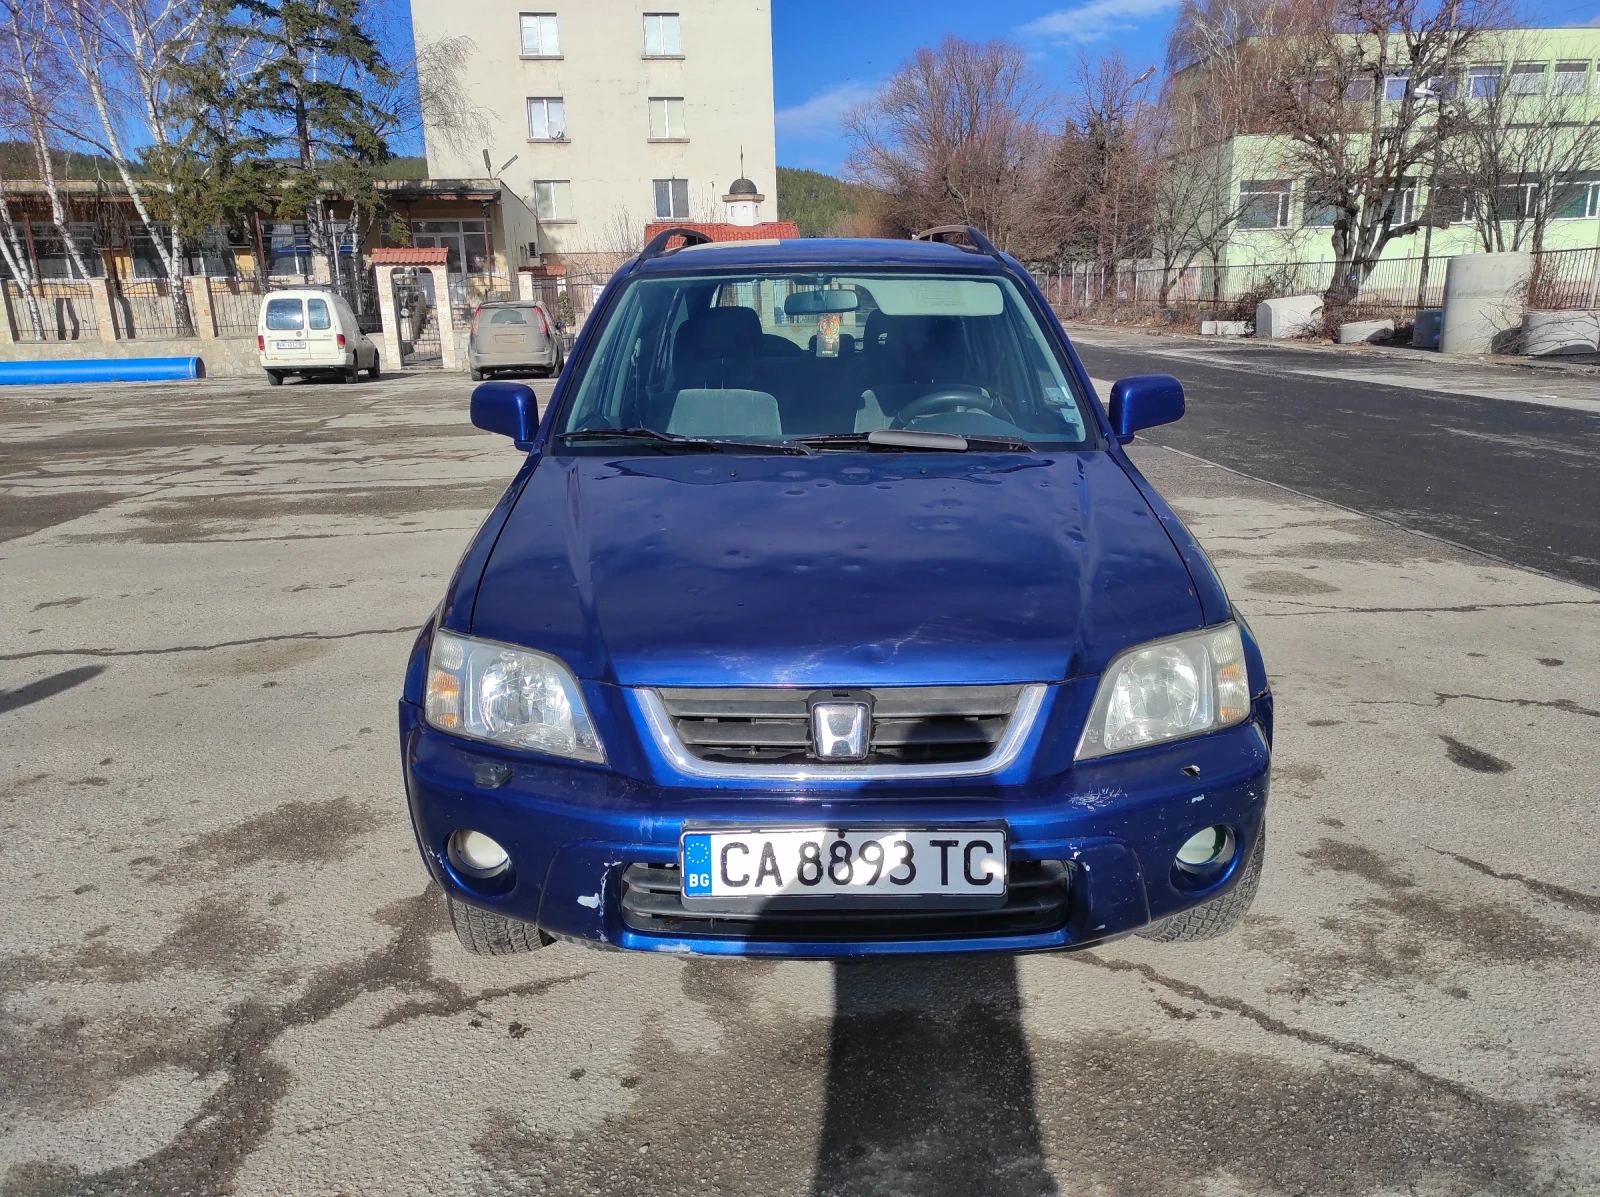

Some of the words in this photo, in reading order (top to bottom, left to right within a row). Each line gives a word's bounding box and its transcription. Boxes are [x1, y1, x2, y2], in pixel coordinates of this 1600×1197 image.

[720, 841, 784, 887] CA
[798, 840, 917, 886] 8893
[929, 840, 994, 886] TC
[689, 873, 710, 888] BG
